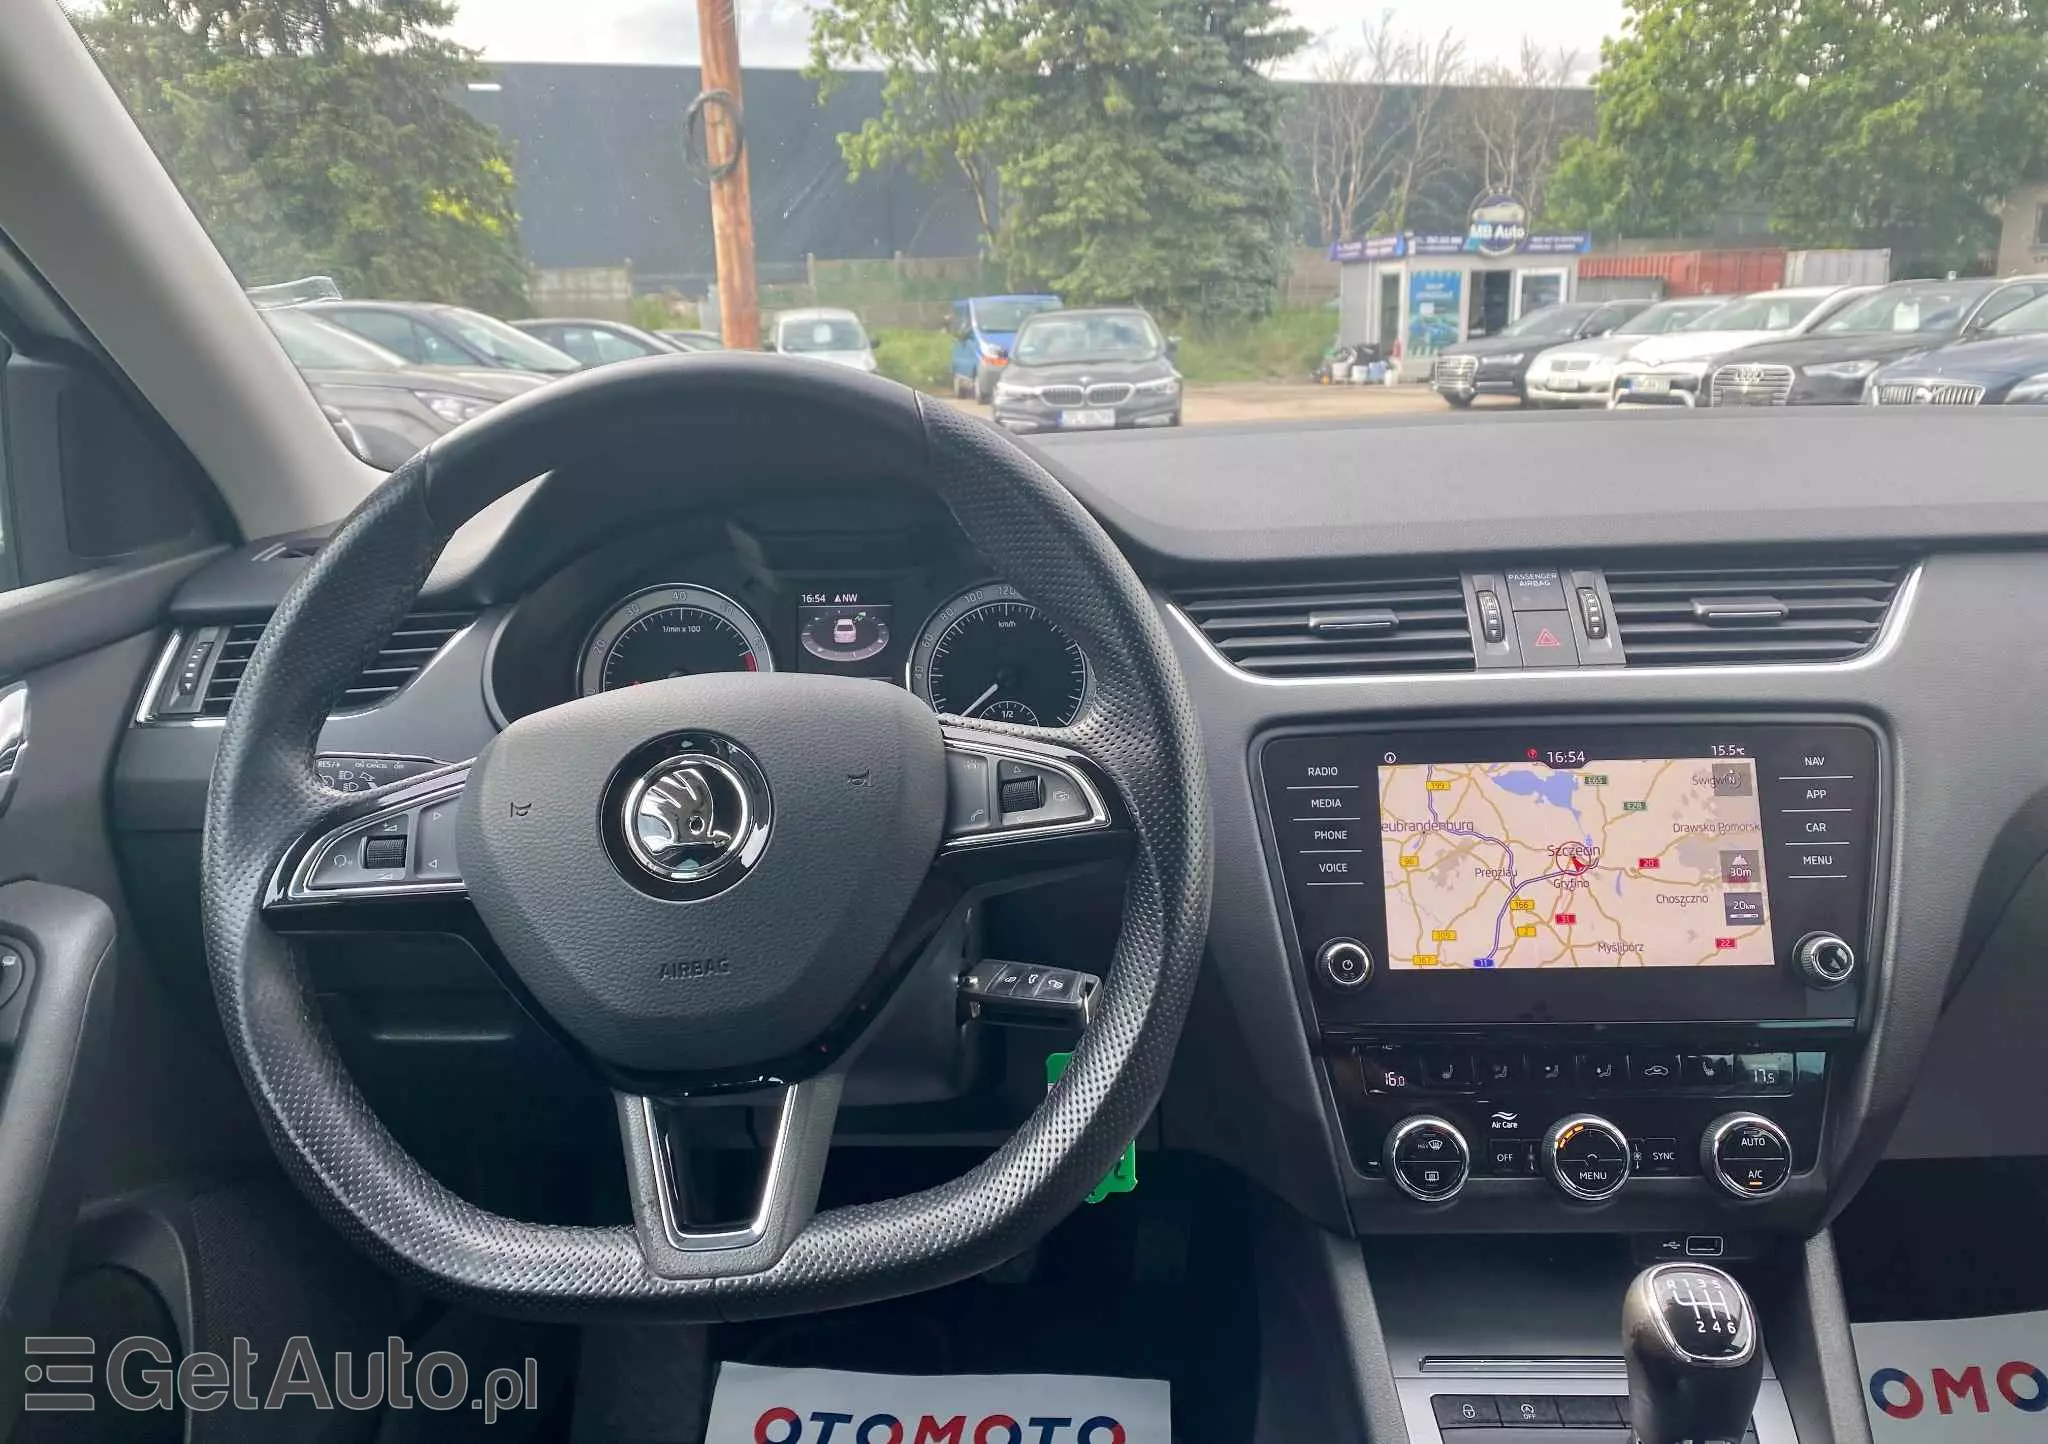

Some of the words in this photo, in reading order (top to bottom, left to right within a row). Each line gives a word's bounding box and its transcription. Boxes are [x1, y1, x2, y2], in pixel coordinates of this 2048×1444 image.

[1494, 224, 1525, 240] Auto
[671, 591, 688, 601] 40
[801, 594, 826, 603] 16:54
[842, 593, 858, 603] NW
[964, 590, 984, 603] 100
[1547, 750, 1586, 764] 16:54
[1804, 756, 1825, 766] NAV
[1307, 766, 1339, 777] RADIO
[1806, 789, 1827, 800] APP
[1311, 798, 1343, 809] MEDIA
[1673, 822, 1715, 833] Drawsko
[1805, 822, 1827, 833] CAR
[1313, 830, 1349, 840] PHONE
[1547, 844, 1601, 859] Szczecin
[1803, 855, 1833, 865] MENU
[1318, 862, 1349, 873] VOICE
[1474, 867, 1518, 878] Prenzlau
[1552, 878, 1590, 890] Gryfino
[1655, 894, 1709, 905] Choszczno
[660, 959, 732, 981] AIRBAG
[1384, 1071, 1405, 1087] 16.0
[1491, 1120, 1502, 1129] Air
[1502, 1120, 1518, 1129] Care
[1741, 1137, 1765, 1147] AUTO
[1497, 1153, 1513, 1162] OFF
[1652, 1151, 1675, 1161] SYNC
[1579, 1171, 1607, 1181] MENU
[1748, 1170, 1763, 1179] A/C
[1666, 1279, 1677, 1289] R
[1697, 1278, 1707, 1288] 3
[1696, 1320, 1706, 1333] 2
[1712, 1320, 1721, 1333] 4
[1727, 1322, 1737, 1334] 6
[753, 1406, 1127, 1444] OTOMOTO
